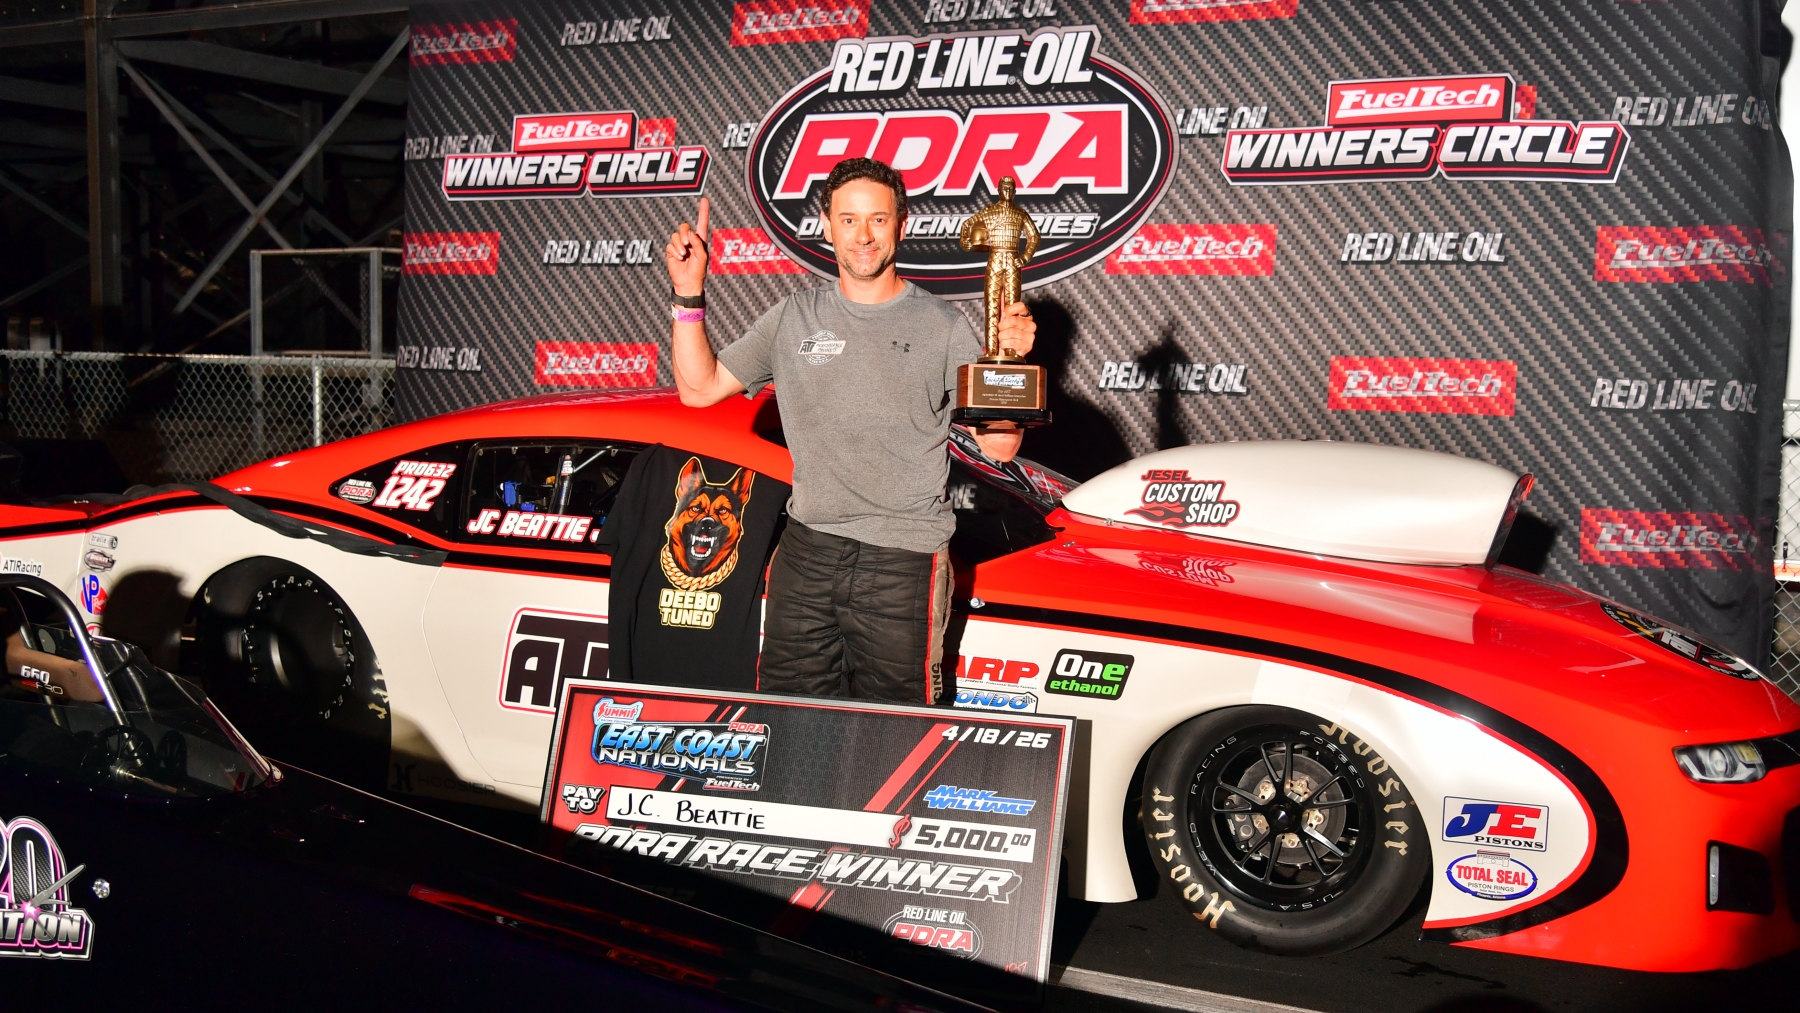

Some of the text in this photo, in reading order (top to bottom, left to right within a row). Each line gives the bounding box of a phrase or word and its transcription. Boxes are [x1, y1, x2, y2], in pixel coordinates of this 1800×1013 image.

[743, 5, 860, 34] FuelTech
[924, 0, 967, 23] RED
[970, 0, 1018, 19] LINE
[411, 30, 509, 56] FuelTech
[561, 15, 672, 46] RED LINE OIL
[828, 31, 1094, 93] RED LINE OIL
[1337, 83, 1501, 118] FuelTech
[1611, 96, 1668, 126] RED
[1672, 94, 1739, 127] LINE
[518, 119, 630, 147] FuelTech
[1176, 107, 1229, 135] LINE
[404, 137, 430, 161] RED
[777, 108, 1126, 197] PDRA
[1227, 126, 1614, 169] WINNERS CIRCLE
[445, 149, 702, 187] WINNERS CIRCLE
[406, 243, 490, 264] FuelTech
[543, 239, 653, 265] RED LINE OIL
[721, 237, 786, 263] Fuel
[1119, 236, 1264, 262] FuelTech
[1341, 231, 1506, 262] RED LINE OIL
[1610, 239, 1771, 268] FuelTech
[397, 344, 481, 371] RED LINE OIL
[544, 351, 649, 375] FuelTech
[1099, 361, 1146, 389] RED
[1208, 363, 1247, 392] OIL
[1341, 368, 1502, 400] FuelTech
[1590, 378, 1757, 414] RED LINE OIL
[393, 461, 456, 478] PRO632
[1141, 469, 1192, 482] JESEL
[340, 485, 374, 497] PDRA
[373, 475, 446, 511] 1242
[1144, 483, 1222, 503] CUSTOM
[468, 510, 500, 533] JC
[499, 511, 592, 541] BEATTIE
[1185, 503, 1238, 523] SHOP
[1595, 522, 1758, 553] FuelTech
[3, 559, 42, 577] ATIRacing
[660, 590, 720, 611] DEEBO
[661, 608, 714, 628] TUNED
[20, 664, 51, 685] 660
[1055, 653, 1125, 682] One
[1050, 679, 1120, 696] ethanol
[728, 722, 764, 734] PDRA
[601, 724, 767, 760] EAST COAST
[600, 747, 757, 775] NATIONALS
[1190, 730, 1365, 795] RACING FORGED
[563, 785, 602, 800] PAY
[704, 778, 760, 791] FuelTech
[926, 785, 995, 800] MARK
[567, 796, 596, 812] TO
[617, 794, 660, 818] J.C.
[926, 797, 1036, 815] WILLIAMS
[889, 814, 912, 850] $
[1445, 803, 1541, 839] JE
[1190, 822, 1217, 876] WELD
[1474, 836, 1544, 850] PISTONS
[575, 824, 1014, 898] PDRA RACE WINNER
[1456, 865, 1528, 887] TOTAL SEAL
[1467, 882, 1515, 893] PISTON RINGS
[903, 906, 967, 925] RED LINE OIL
[892, 923, 974, 952] PDRA
